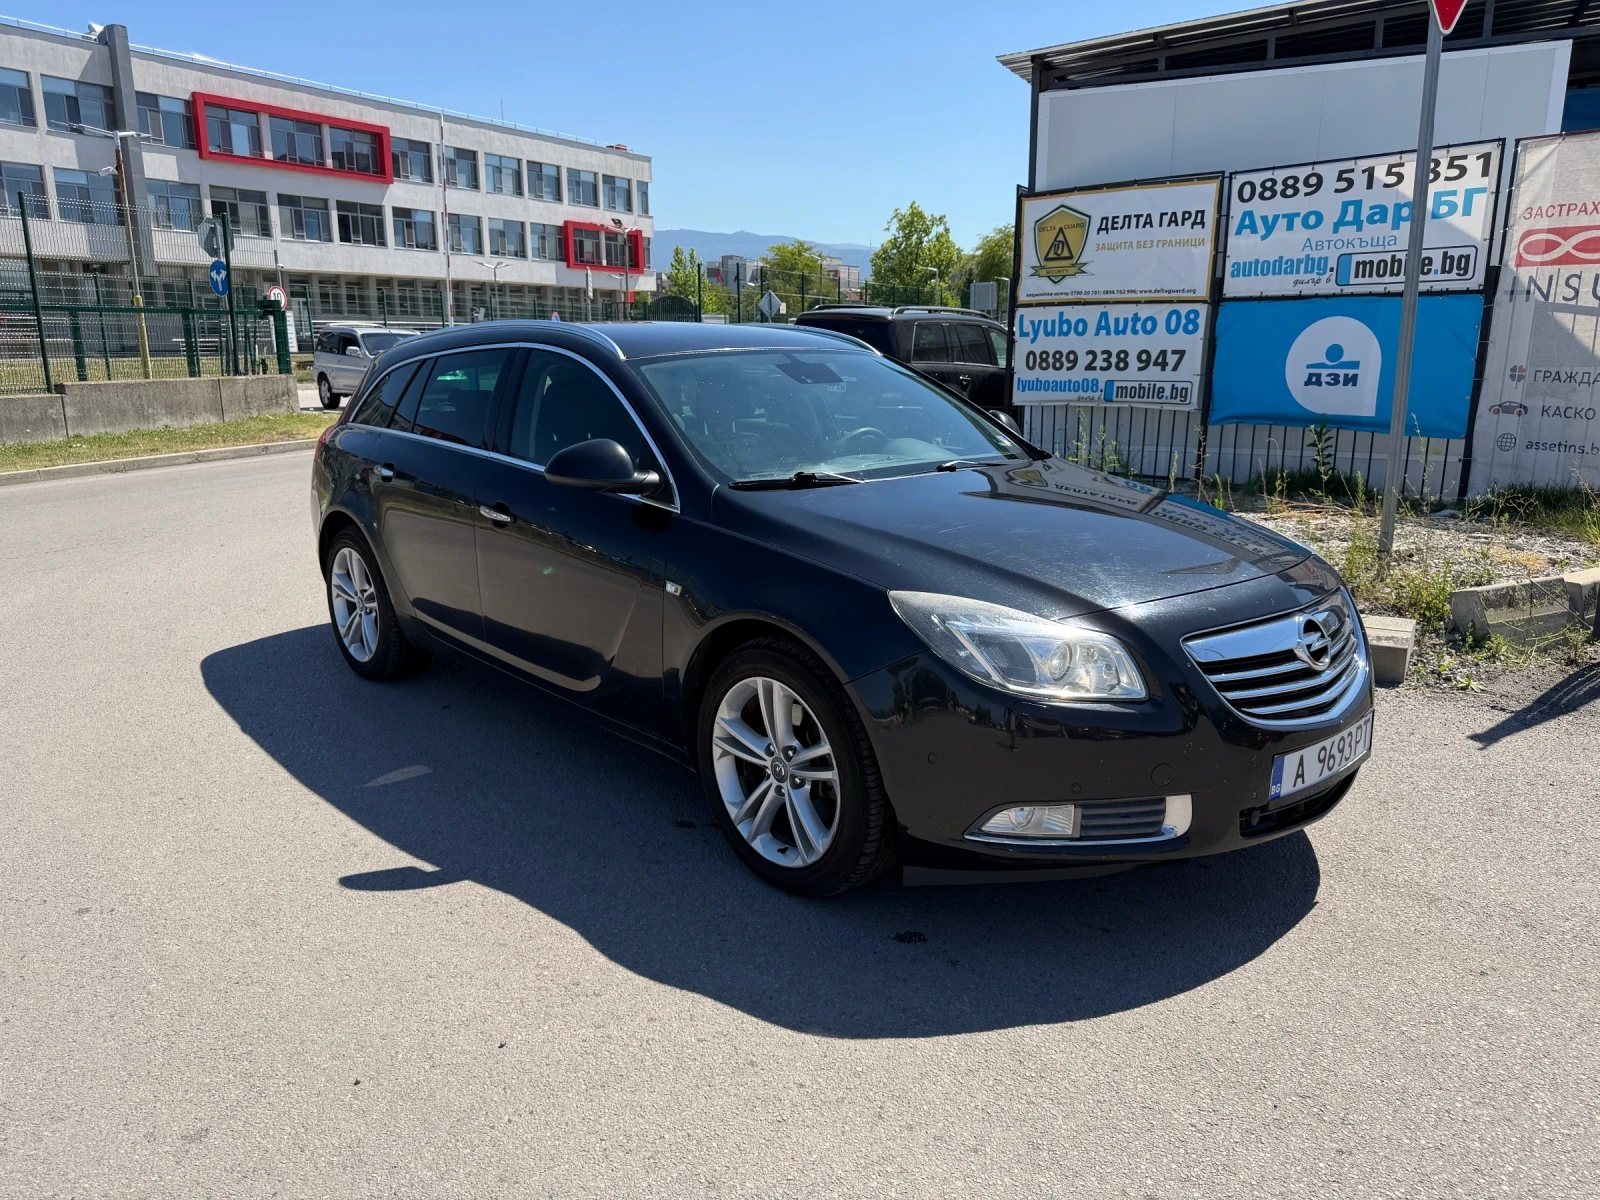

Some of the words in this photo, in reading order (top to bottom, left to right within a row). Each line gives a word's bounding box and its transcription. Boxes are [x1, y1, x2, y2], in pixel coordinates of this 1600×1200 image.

[1237, 172, 1324, 204] 0889
[1333, 162, 1405, 194] 515
[1096, 212, 1154, 236] ДЕЛТА
[1158, 209, 1206, 230] ГАРД
[1234, 210, 1324, 242] Ауто
[1332, 198, 1413, 234] Дар
[1430, 186, 1488, 220] БГ
[1038, 225, 1057, 233] DELTA
[1063, 222, 1085, 230] GUARD
[1094, 240, 1135, 252] ЗАЩИТА
[1136, 239, 1154, 250] БЕЗ
[1156, 237, 1206, 249] ГРАНИЦИ
[1301, 233, 1398, 253] Автокъща
[1353, 250, 1471, 277] mobie.bg
[1018, 311, 1089, 345] Lyubo
[1094, 310, 1158, 337] Auto
[1165, 308, 1200, 336] 08
[1025, 349, 1079, 372] 0889
[1083, 349, 1130, 372] 238
[1136, 349, 1187, 372] 947
[1303, 372, 1359, 387] ДЗИ
[1115, 383, 1189, 403] mobile.bg
[1540, 405, 1597, 421] КАСКО
[1270, 783, 1281, 795] BG
[1292, 754, 1305, 788] A
